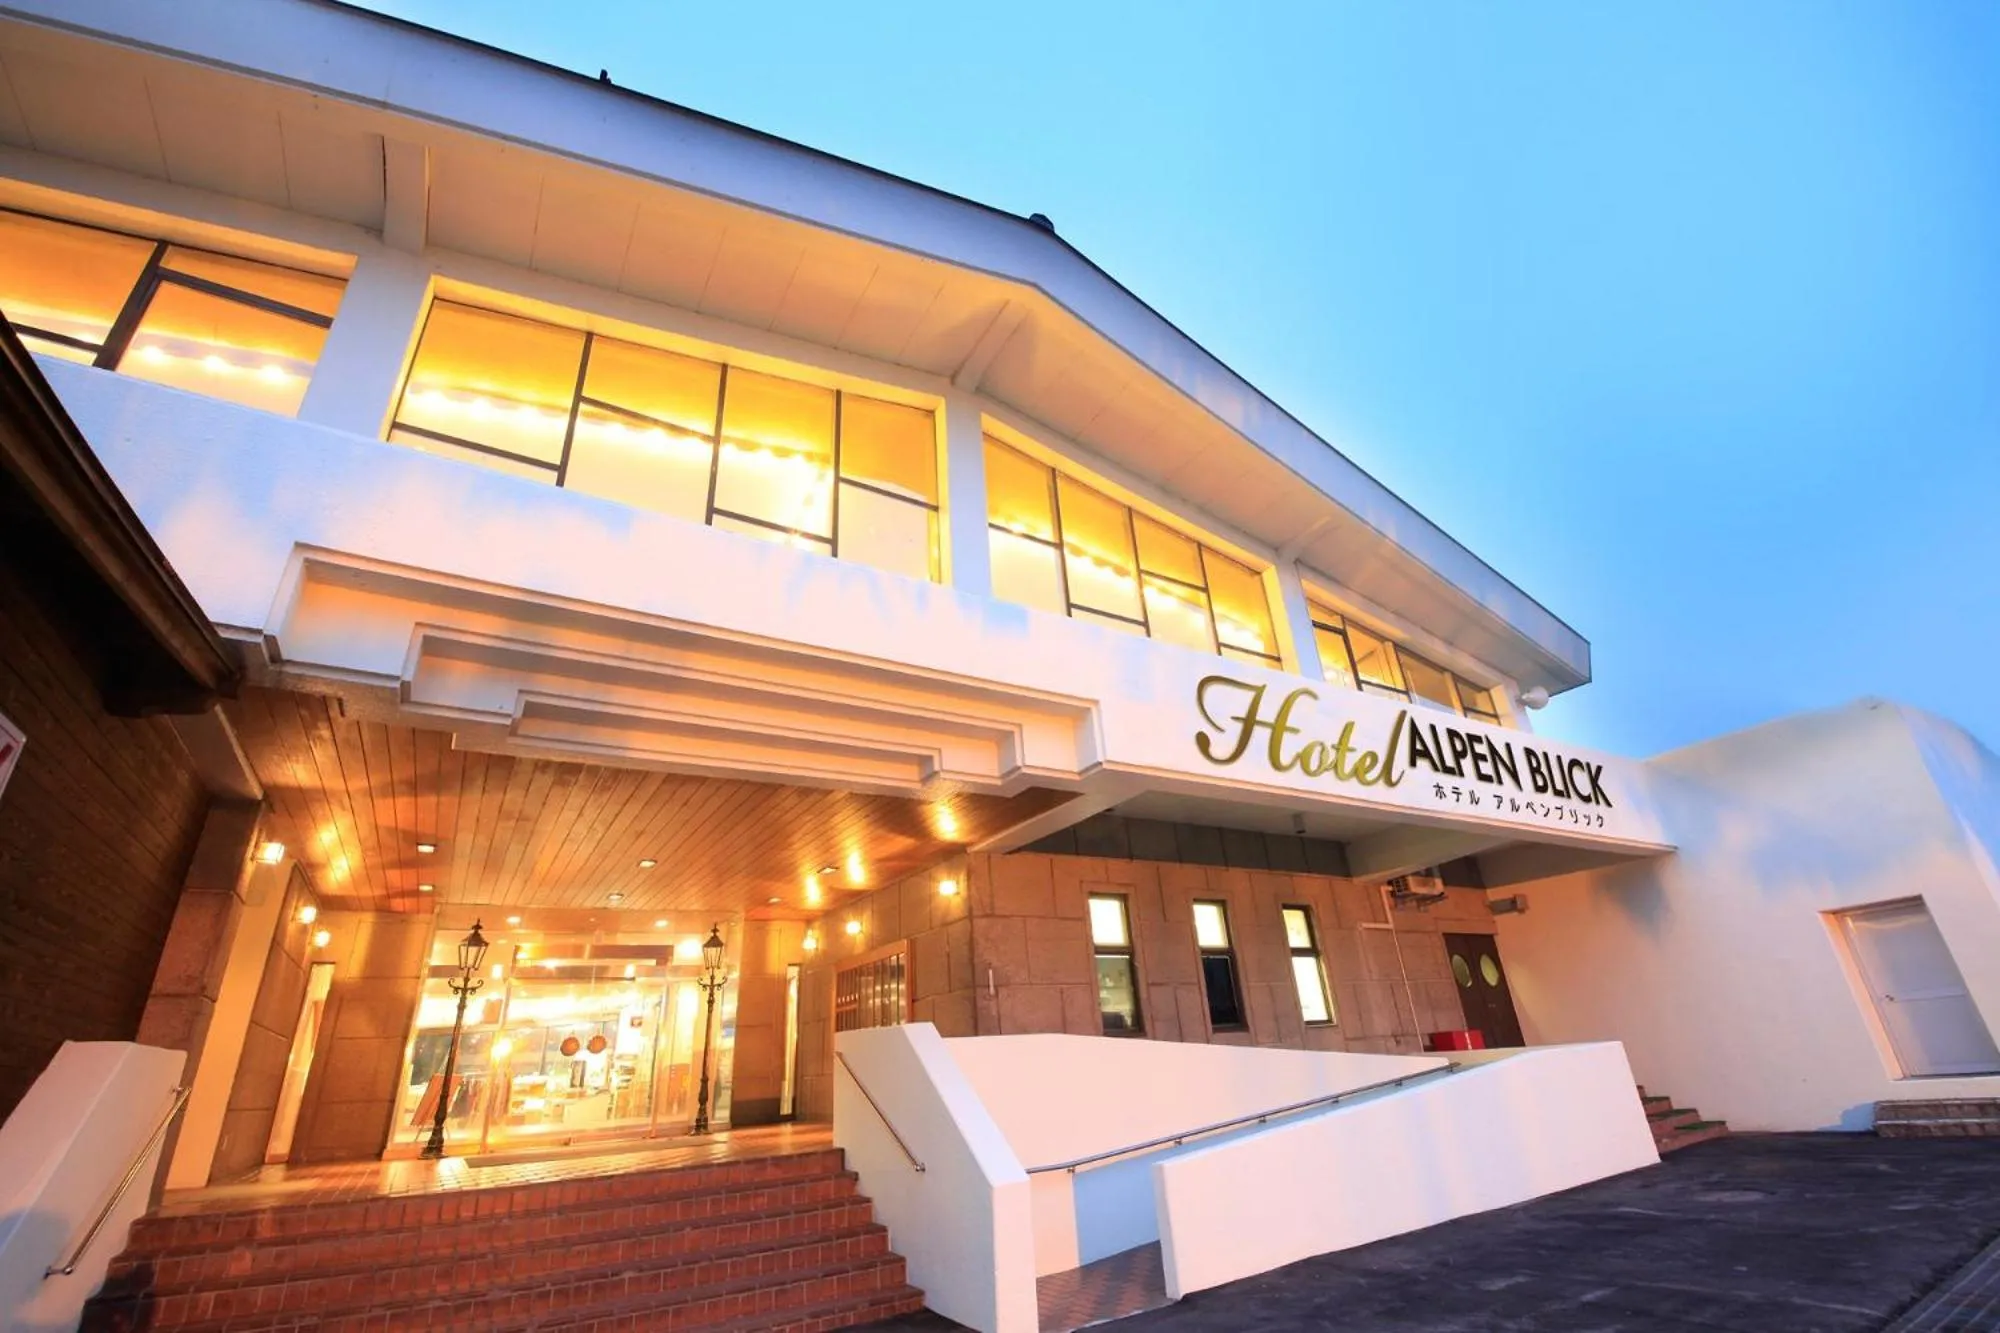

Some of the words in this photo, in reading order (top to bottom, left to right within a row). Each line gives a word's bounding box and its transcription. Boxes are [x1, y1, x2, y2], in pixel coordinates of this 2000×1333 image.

[1195, 675, 1407, 788] Hotel
[1409, 717, 1522, 791] ALPEN
[1524, 746, 1613, 808] BLICK
[1433, 782, 1480, 806] ホテル
